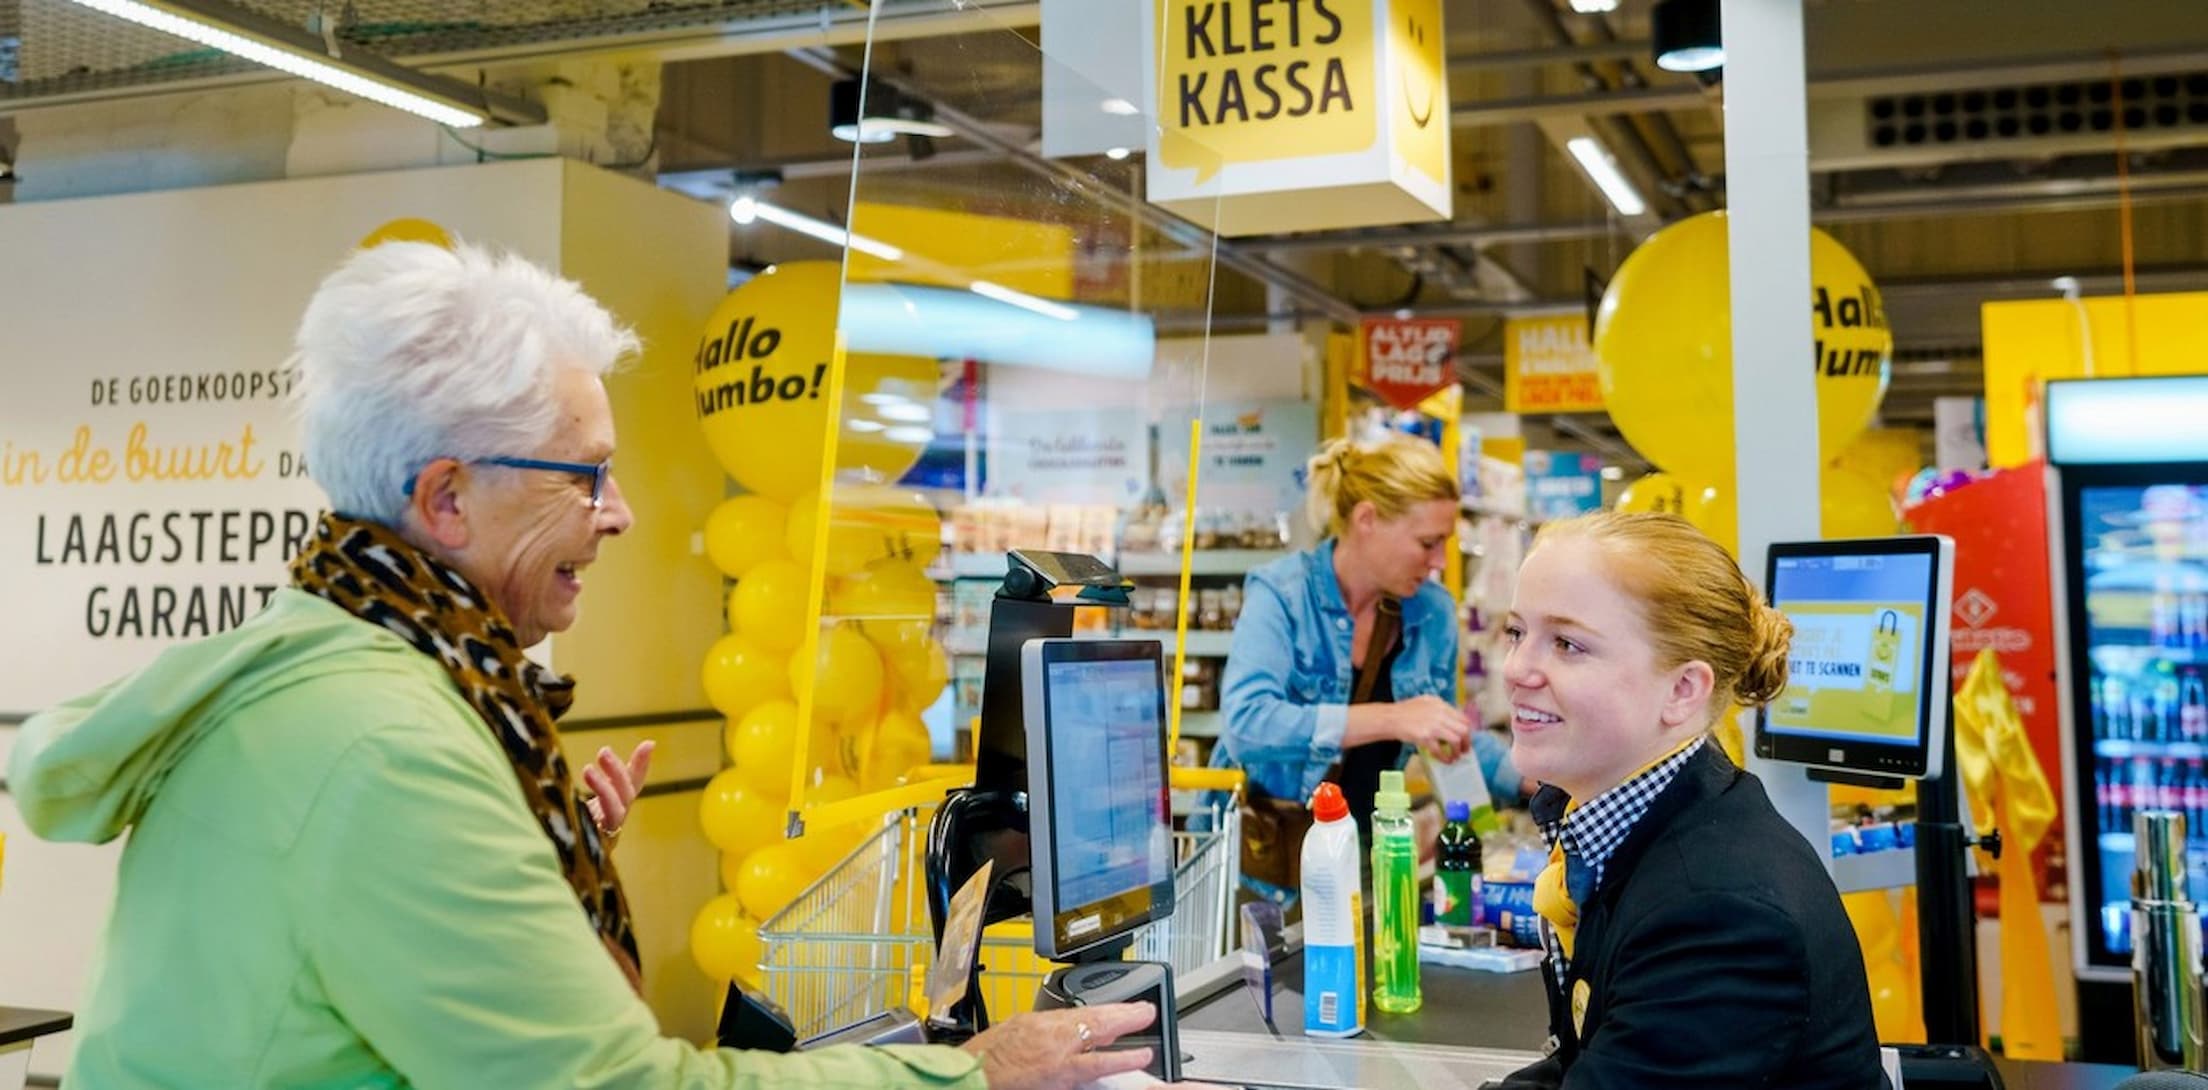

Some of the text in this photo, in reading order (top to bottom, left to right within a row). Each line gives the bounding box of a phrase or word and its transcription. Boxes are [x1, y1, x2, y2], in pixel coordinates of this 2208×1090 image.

[1185, 0, 1342, 59] KLETS
[1179, 57, 1353, 128] KASSA
[91, 368, 305, 405] DE GOEDKOOPST
[2, 440, 49, 486] in
[57, 424, 118, 484] de
[124, 421, 265, 483] buurt
[1806, 661, 1816, 675] TE
[1819, 662, 1861, 677] SCANNEN
